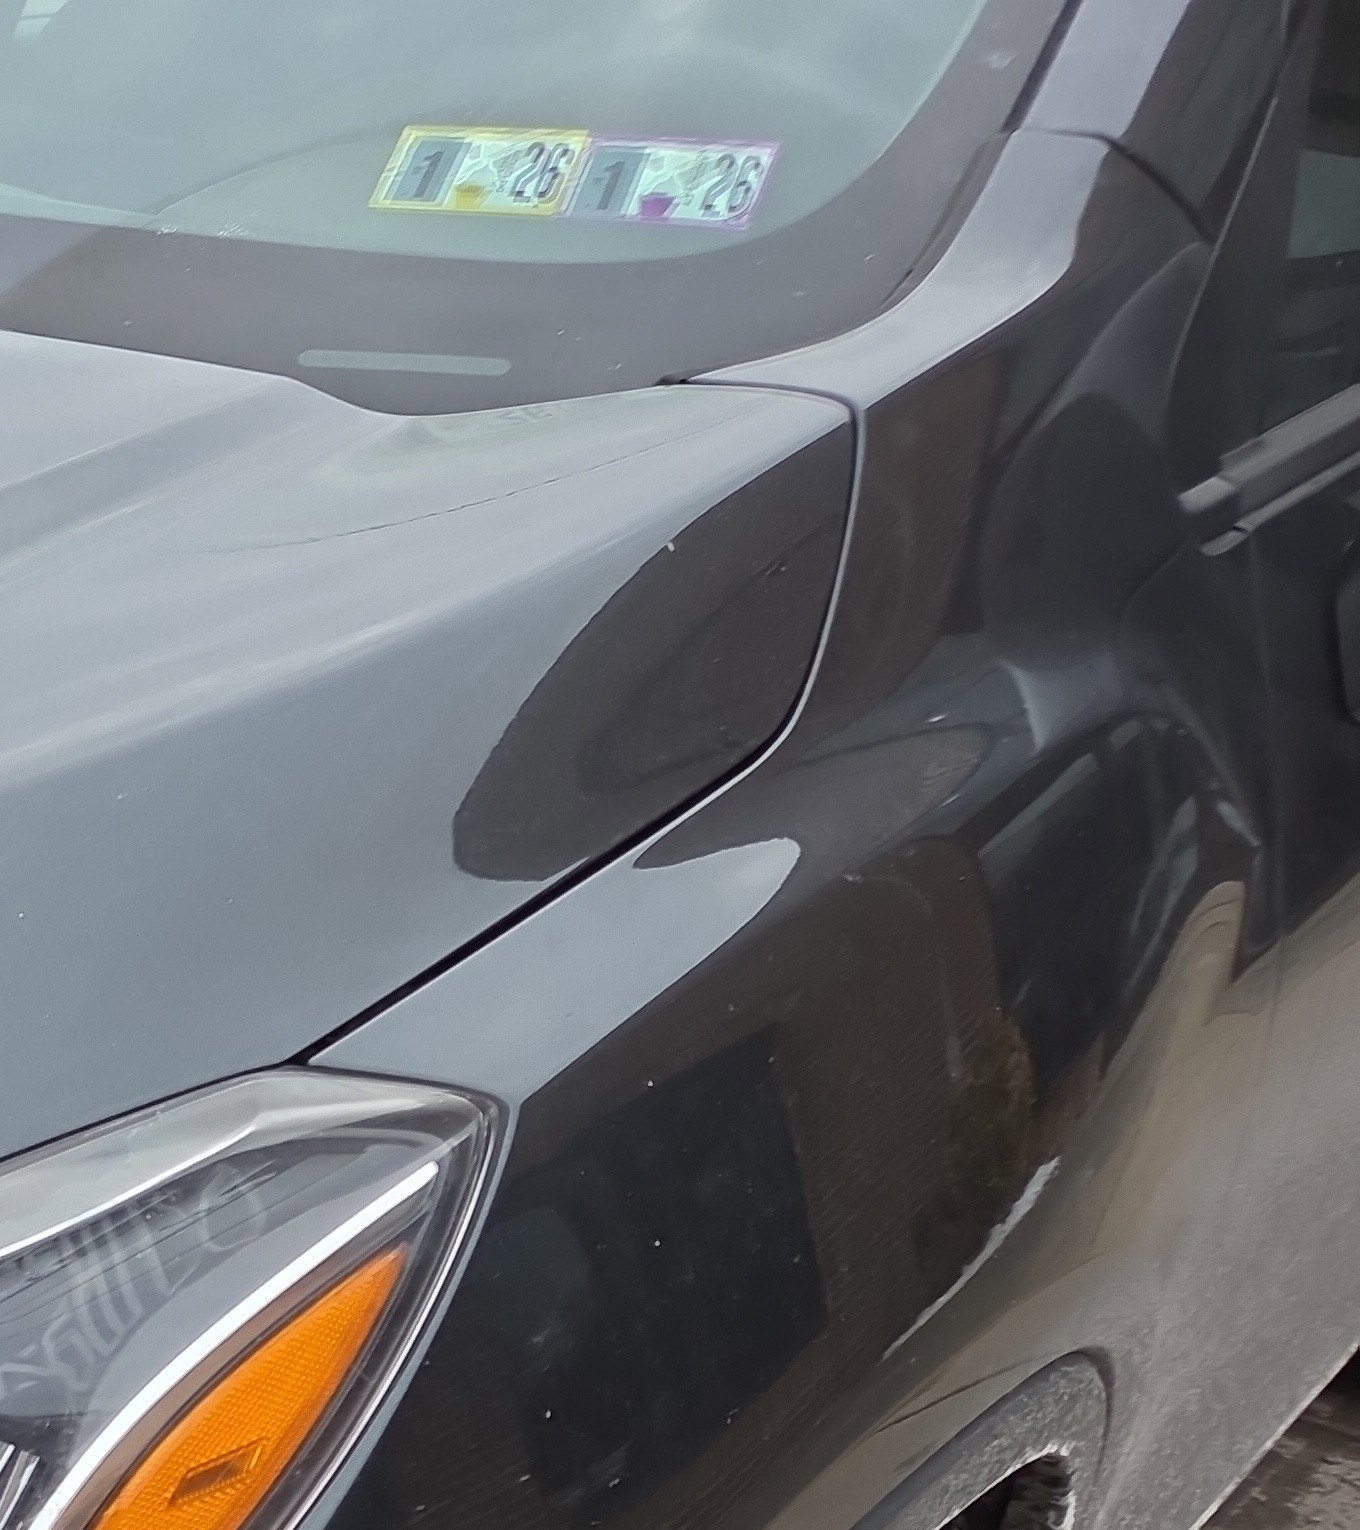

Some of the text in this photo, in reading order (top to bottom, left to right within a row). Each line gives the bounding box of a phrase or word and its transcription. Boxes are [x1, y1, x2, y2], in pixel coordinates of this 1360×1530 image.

[414, 141, 574, 203] 1 26
[595, 153, 764, 217] 1 26
